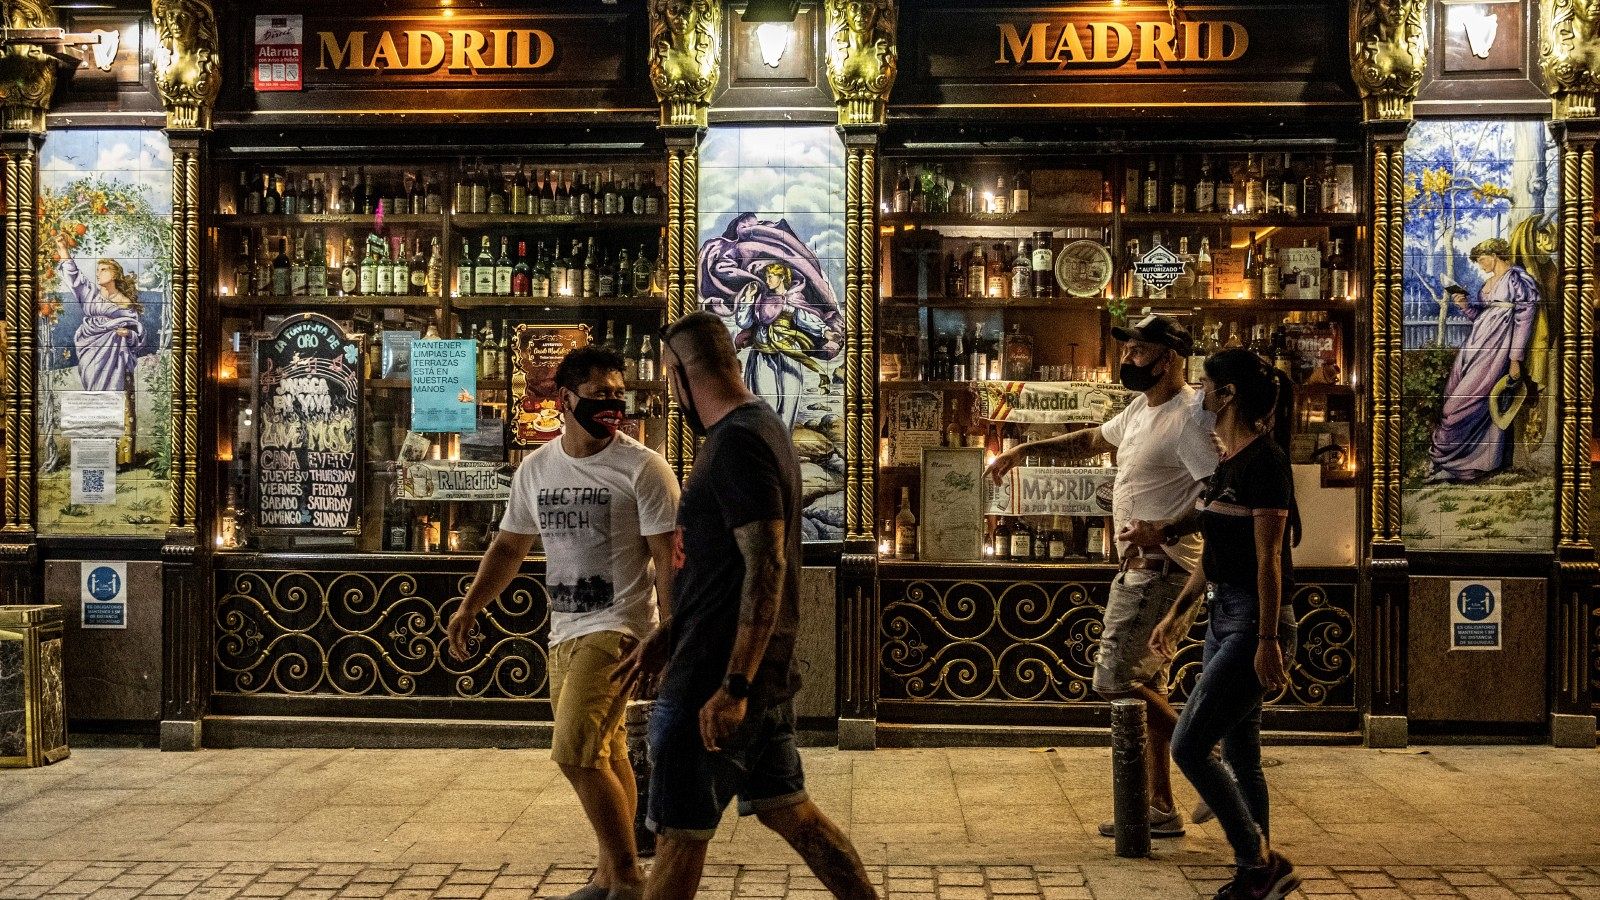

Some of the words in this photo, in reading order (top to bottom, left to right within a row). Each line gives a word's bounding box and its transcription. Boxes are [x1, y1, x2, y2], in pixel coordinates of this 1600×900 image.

[259, 46, 299, 57] Alarma
[316, 29, 555, 70] MADRID
[995, 21, 1250, 64] MADRID
[274, 340, 287, 353] LA
[326, 334, 340, 350] DE
[297, 333, 319, 348] ORO
[413, 341, 462, 349] MANTENER
[413, 350, 448, 358] LIMPIAS
[449, 350, 467, 358] LAS
[414, 359, 459, 367] TERRAZAS
[413, 376, 459, 384] NUESTRAS
[436, 368, 449, 376] EN
[413, 385, 446, 393] MANOS
[1026, 391, 1078, 410] Madrid
[261, 450, 300, 470] CADA
[307, 452, 354, 470] EVERY
[261, 469, 302, 482] JUEVES
[309, 469, 356, 483] THURSDAY
[455, 470, 498, 490] Madrid
[538, 487, 610, 506] ELECTRIC
[1022, 477, 1096, 501] MADRID
[261, 496, 298, 510] SABADO
[307, 495, 353, 513] SATURDAY
[1049, 504, 1059, 512] LA
[313, 510, 349, 528] SUNDAY
[540, 510, 590, 529] BEACH
